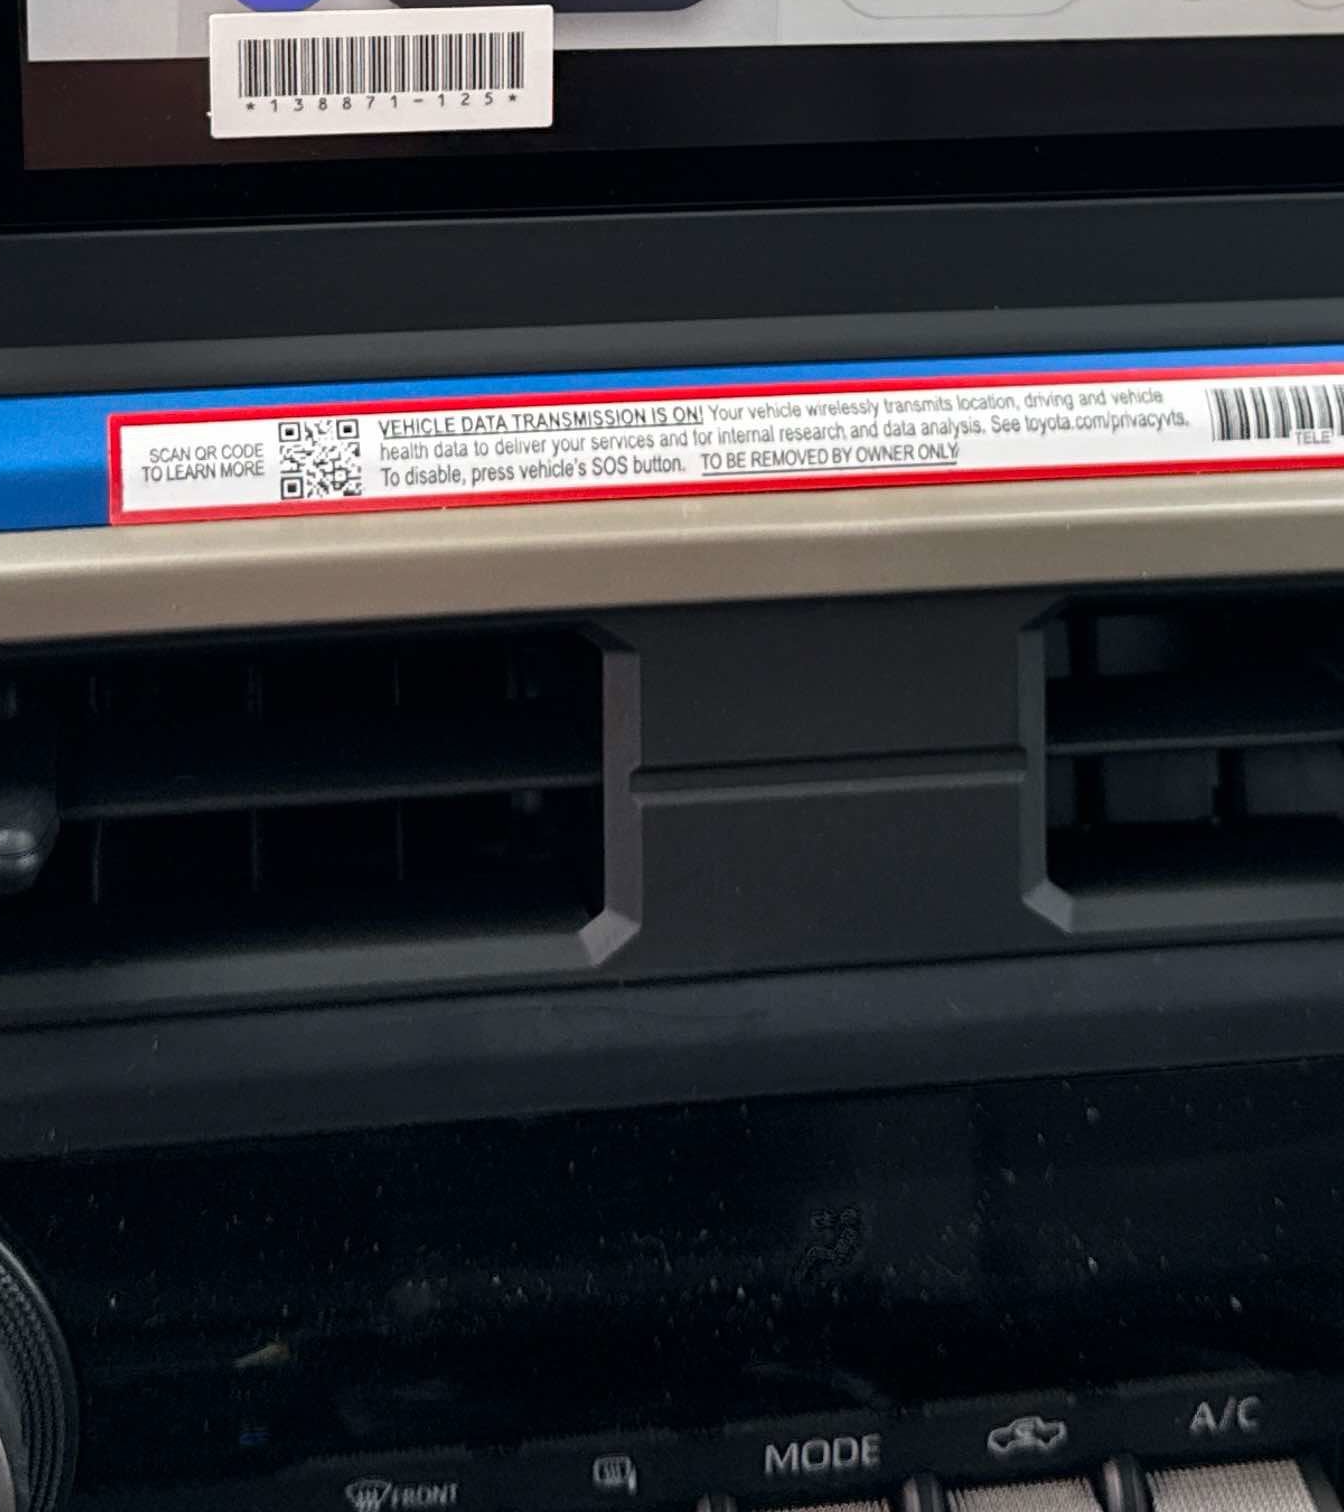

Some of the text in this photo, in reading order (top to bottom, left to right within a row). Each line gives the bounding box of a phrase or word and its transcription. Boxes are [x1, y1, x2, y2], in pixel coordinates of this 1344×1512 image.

[378, 387, 1164, 437] VEHICLE DATA TRANSMISSION IS ON! Your vehicle wirelessly transmits location, driving and vehicle
[149, 442, 264, 464] SCAN QR CODE
[380, 441, 429, 461] health
[434, 439, 469, 459] data
[474, 439, 489, 457] to
[494, 435, 546, 455] deliver
[551, 436, 587, 457] your
[591, 431, 655, 451] services
[659, 429, 688, 447] and
[692, 428, 713, 446] for
[718, 425, 775, 445] internal
[778, 422, 844, 443] research
[850, 420, 878, 439] and
[884, 418, 917, 437] data
[920, 415, 986, 437] analysis.
[991, 414, 1021, 433] See
[1294, 429, 1331, 446] TELE
[142, 459, 265, 482] TO LEARN MORE
[381, 467, 400, 487] To
[405, 464, 467, 486] disable,
[472, 465, 515, 487] press
[519, 456, 587, 480] vehicle's
[592, 455, 628, 476] SOS
[633, 454, 687, 475] button.
[701, 452, 722, 470] TO
[727, 451, 747, 468] BE
[751, 447, 829, 468] REMOVED
[833, 445, 853, 464] BY
[856, 442, 915, 464] OWNER
[1189, 1396, 1260, 1434] A/C
[764, 1432, 882, 1476] MODE
[391, 1482, 458, 1508] FRONT
